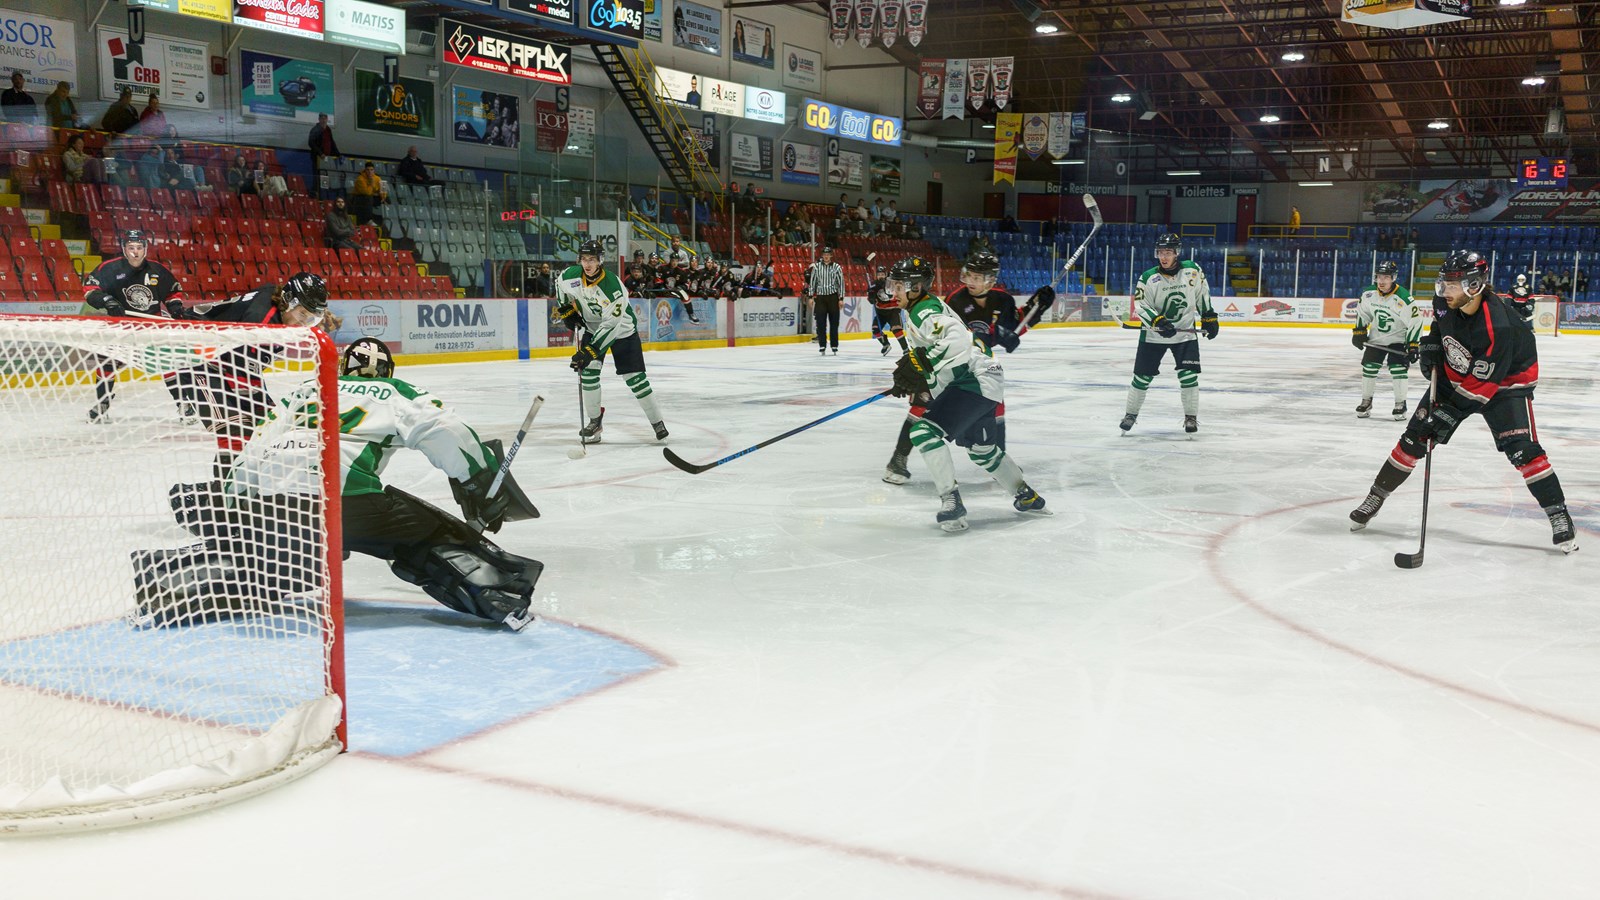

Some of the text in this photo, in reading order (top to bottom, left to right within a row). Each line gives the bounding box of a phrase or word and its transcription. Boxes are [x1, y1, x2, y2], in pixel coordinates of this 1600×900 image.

[130, 12, 143, 42] U
[352, 11, 395, 30] MATISS
[0, 18, 56, 49] SOR
[134, 66, 160, 84] CRB
[256, 65, 271, 74] FAIS
[386, 59, 397, 83] T
[557, 88, 567, 111] S
[760, 95, 771, 106] KIA
[374, 109, 419, 123] CONDORS
[704, 118, 713, 134] R
[828, 139, 838, 155] Q
[966, 149, 976, 162] P
[1319, 158, 1329, 173] N
[1553, 165, 1566, 178] 12
[1047, 182, 1116, 194] Bar Restaurant
[1182, 186, 1225, 197] Toilettes
[417, 303, 489, 328] RONA
[612, 303, 622, 317] 3
[357, 314, 388, 328] VICTORIA
[409, 329, 496, 340] Centre de Rénovation André Lessard
[435, 341, 475, 350] 418 228-9725
[1472, 360, 1496, 380] 21
[338, 384, 392, 400] HARD
